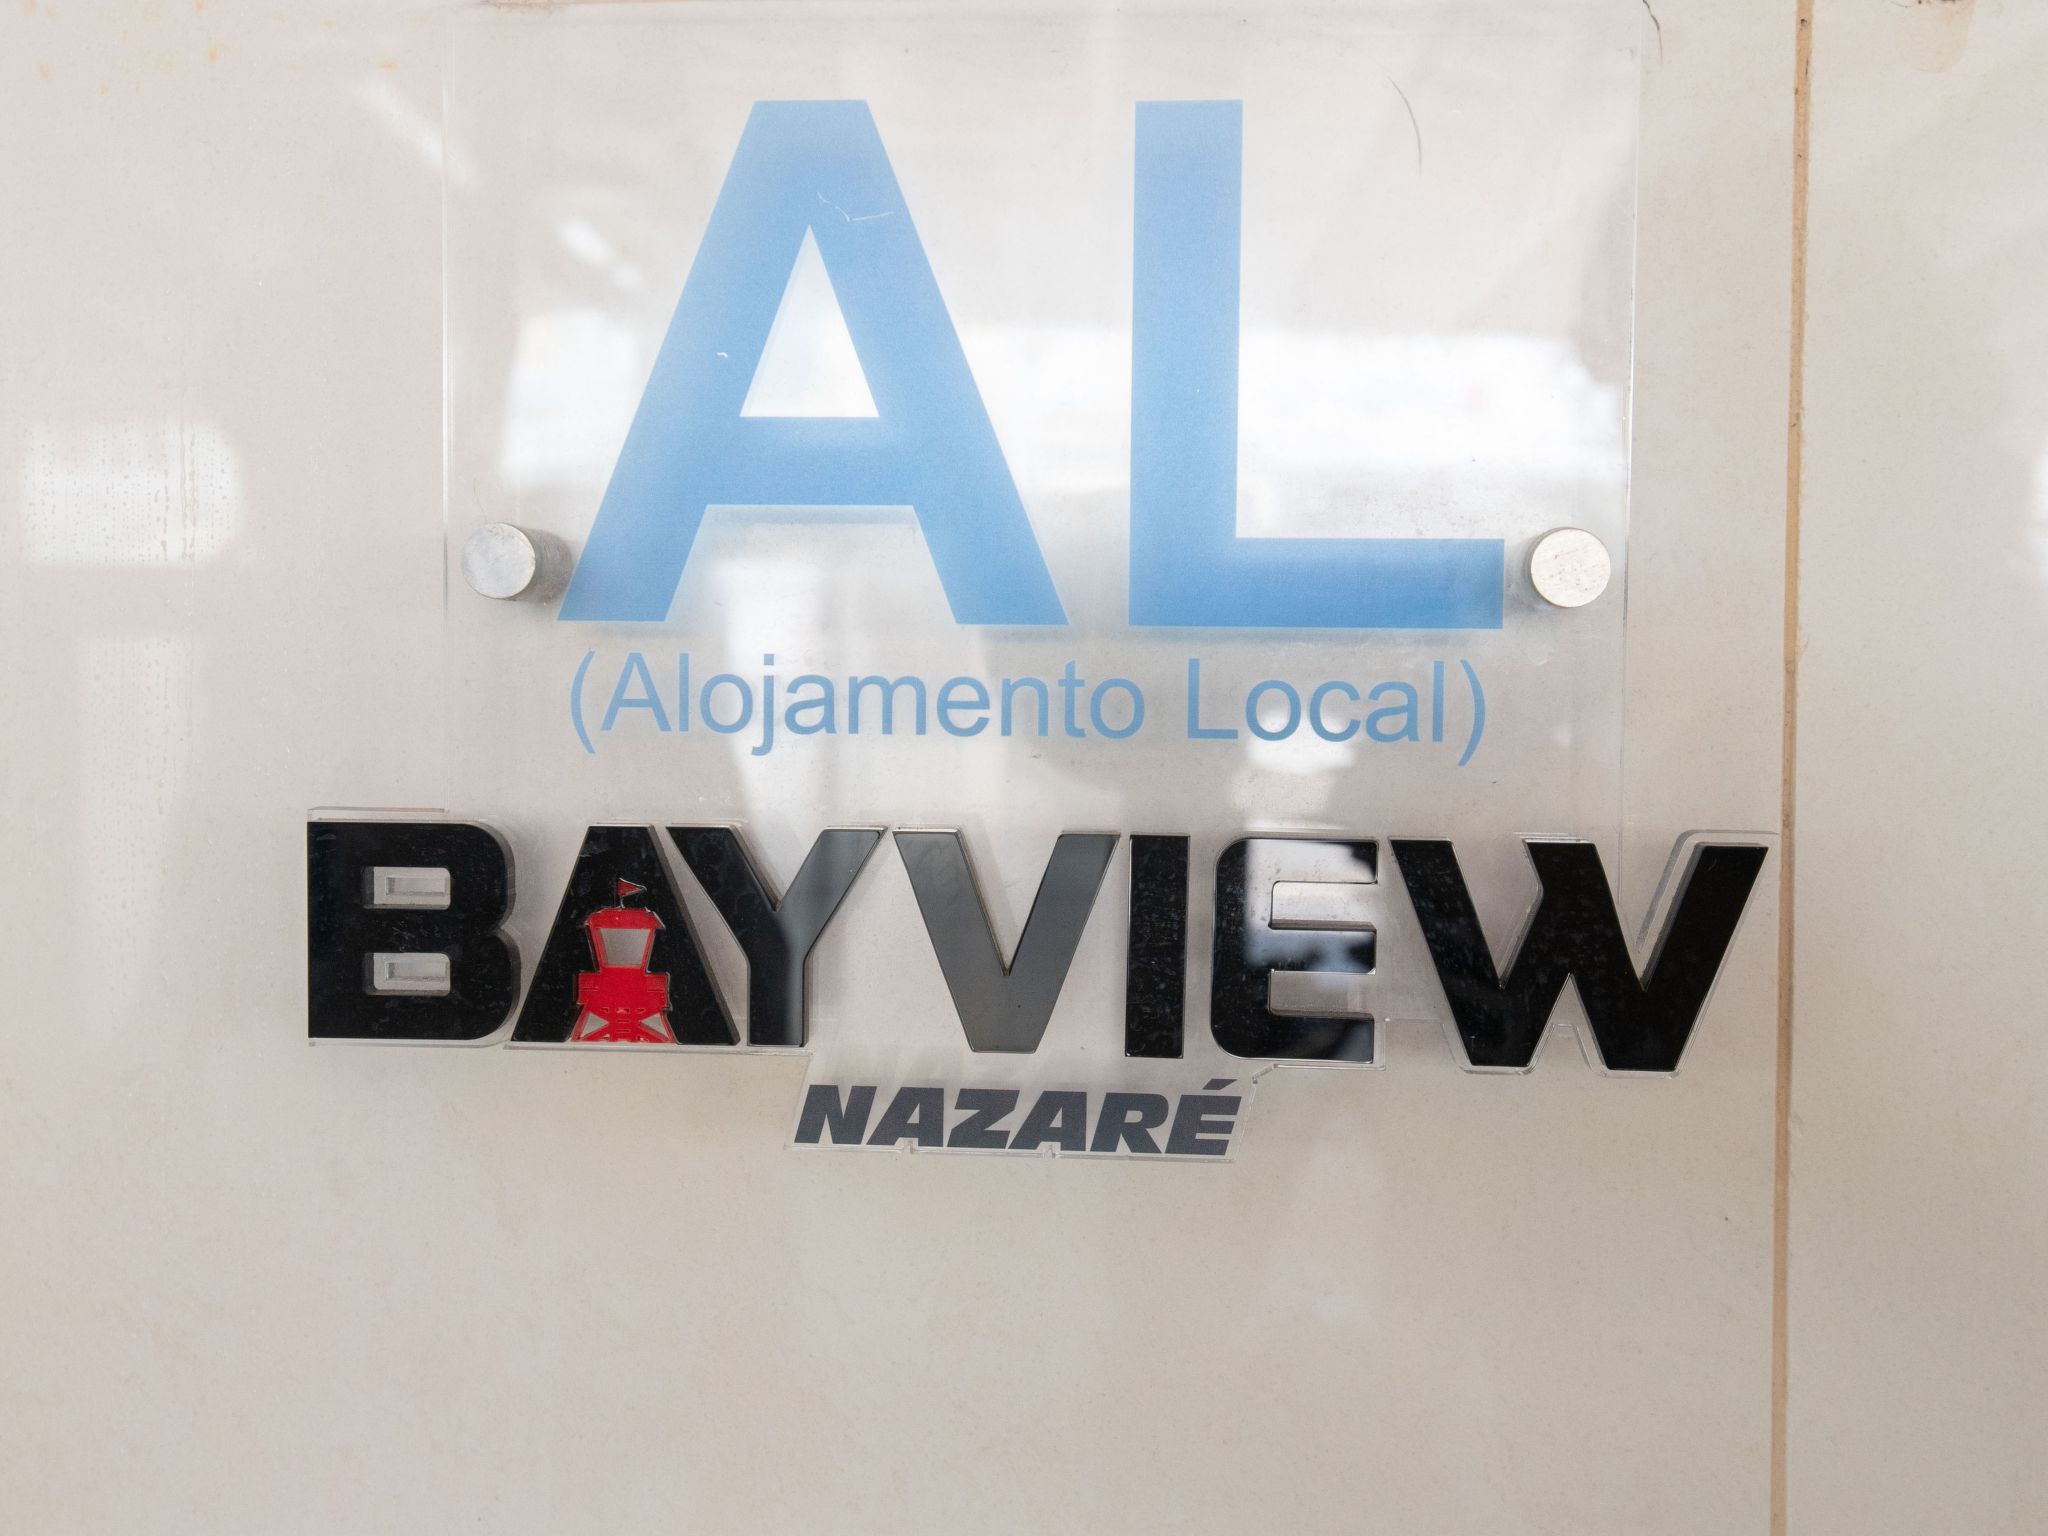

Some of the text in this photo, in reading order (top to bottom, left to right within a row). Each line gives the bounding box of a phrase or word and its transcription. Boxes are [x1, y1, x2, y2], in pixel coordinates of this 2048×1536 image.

[558, 99, 1505, 630] AL
[570, 650, 1487, 766] (Alojamento Local)
[307, 822, 1770, 1073] BAYVIEW
[796, 1079, 1242, 1157] NAZARÉ
